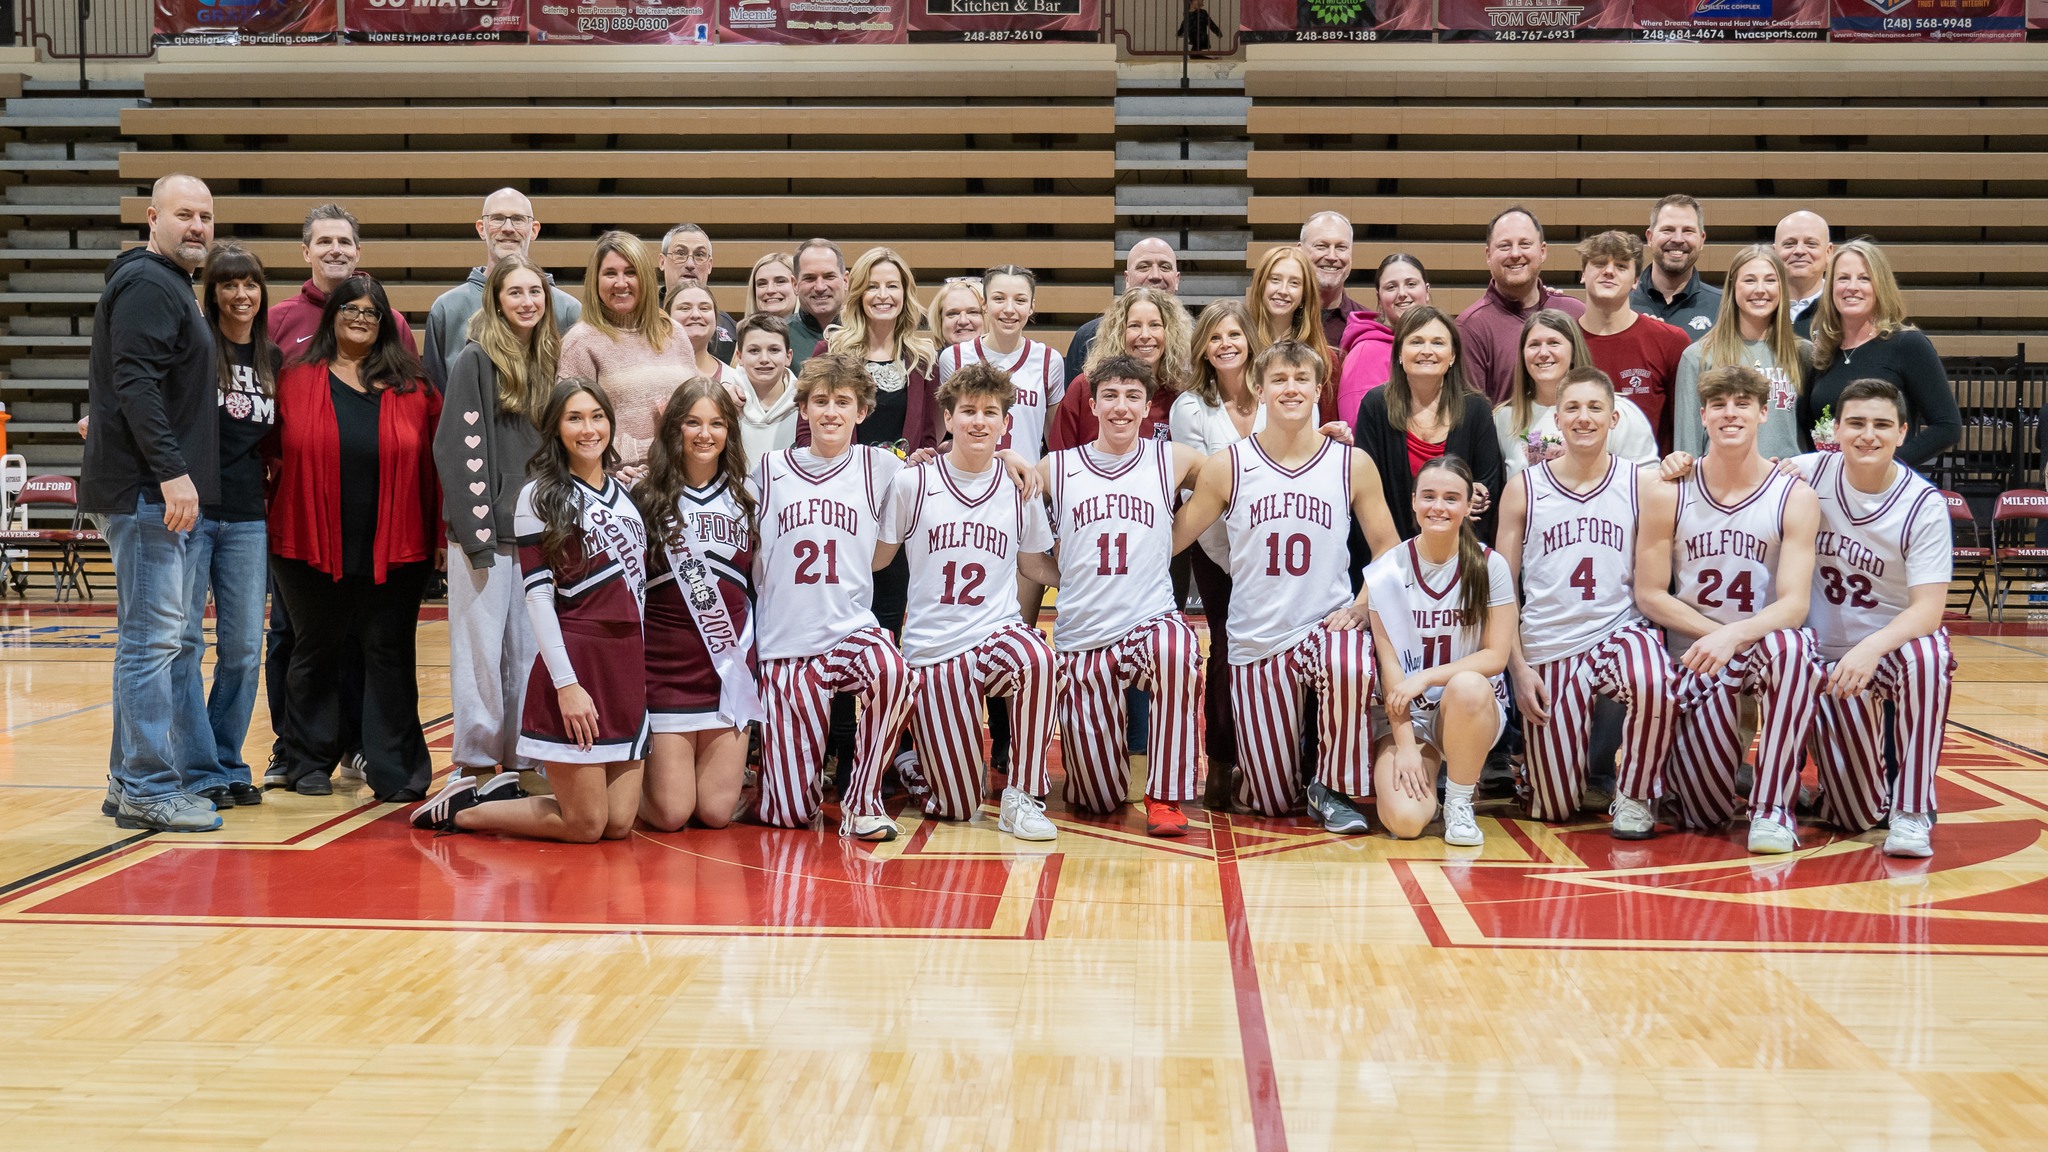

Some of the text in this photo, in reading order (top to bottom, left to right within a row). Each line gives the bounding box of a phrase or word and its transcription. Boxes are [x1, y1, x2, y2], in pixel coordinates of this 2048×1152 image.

[542, 6, 568, 16] Catering
[593, 6, 627, 16] Processing
[730, 7, 776, 20] Meemic
[951, 0, 1061, 12] Kitchen & Bar
[1488, 12, 1580, 26] TOM GAUNT
[368, 33, 500, 42] HONESTMORTGAGE.COM
[578, 18, 668, 32] (248) 889-0300
[787, 20, 809, 29] Home
[814, 20, 833, 29] Auto
[964, 31, 1043, 41] 248-887-2610
[1296, 31, 1376, 41] 248-889-1388
[1495, 30, 1575, 41] 248-767-6931
[1642, 29, 1818, 41] 248-684-4674 hvacsports.com
[1883, 18, 1972, 30] (248) 568-9948
[26, 481, 72, 491] MILFORD
[2002, 496, 2048, 506] MILFOR
[777, 498, 858, 539] MILFORD
[1072, 493, 1155, 533] MILFORD
[1250, 492, 1332, 530] MILFORD
[591, 509, 642, 578] Senior
[928, 521, 1008, 560] MILFORD
[1097, 532, 1129, 576] 11
[1265, 532, 1312, 577] 10
[1542, 517, 1624, 557] MILFORD
[1684, 529, 1768, 564] MILFORD
[1814, 530, 1885, 577] ILFORD
[793, 539, 840, 585] 21
[1570, 557, 1596, 601] 4
[686, 567, 709, 602] MHS
[940, 561, 987, 606] 12
[1697, 568, 1755, 613] 24
[1819, 565, 1879, 609] 32
[698, 609, 737, 654] 2025
[1422, 635, 1451, 670] 11
